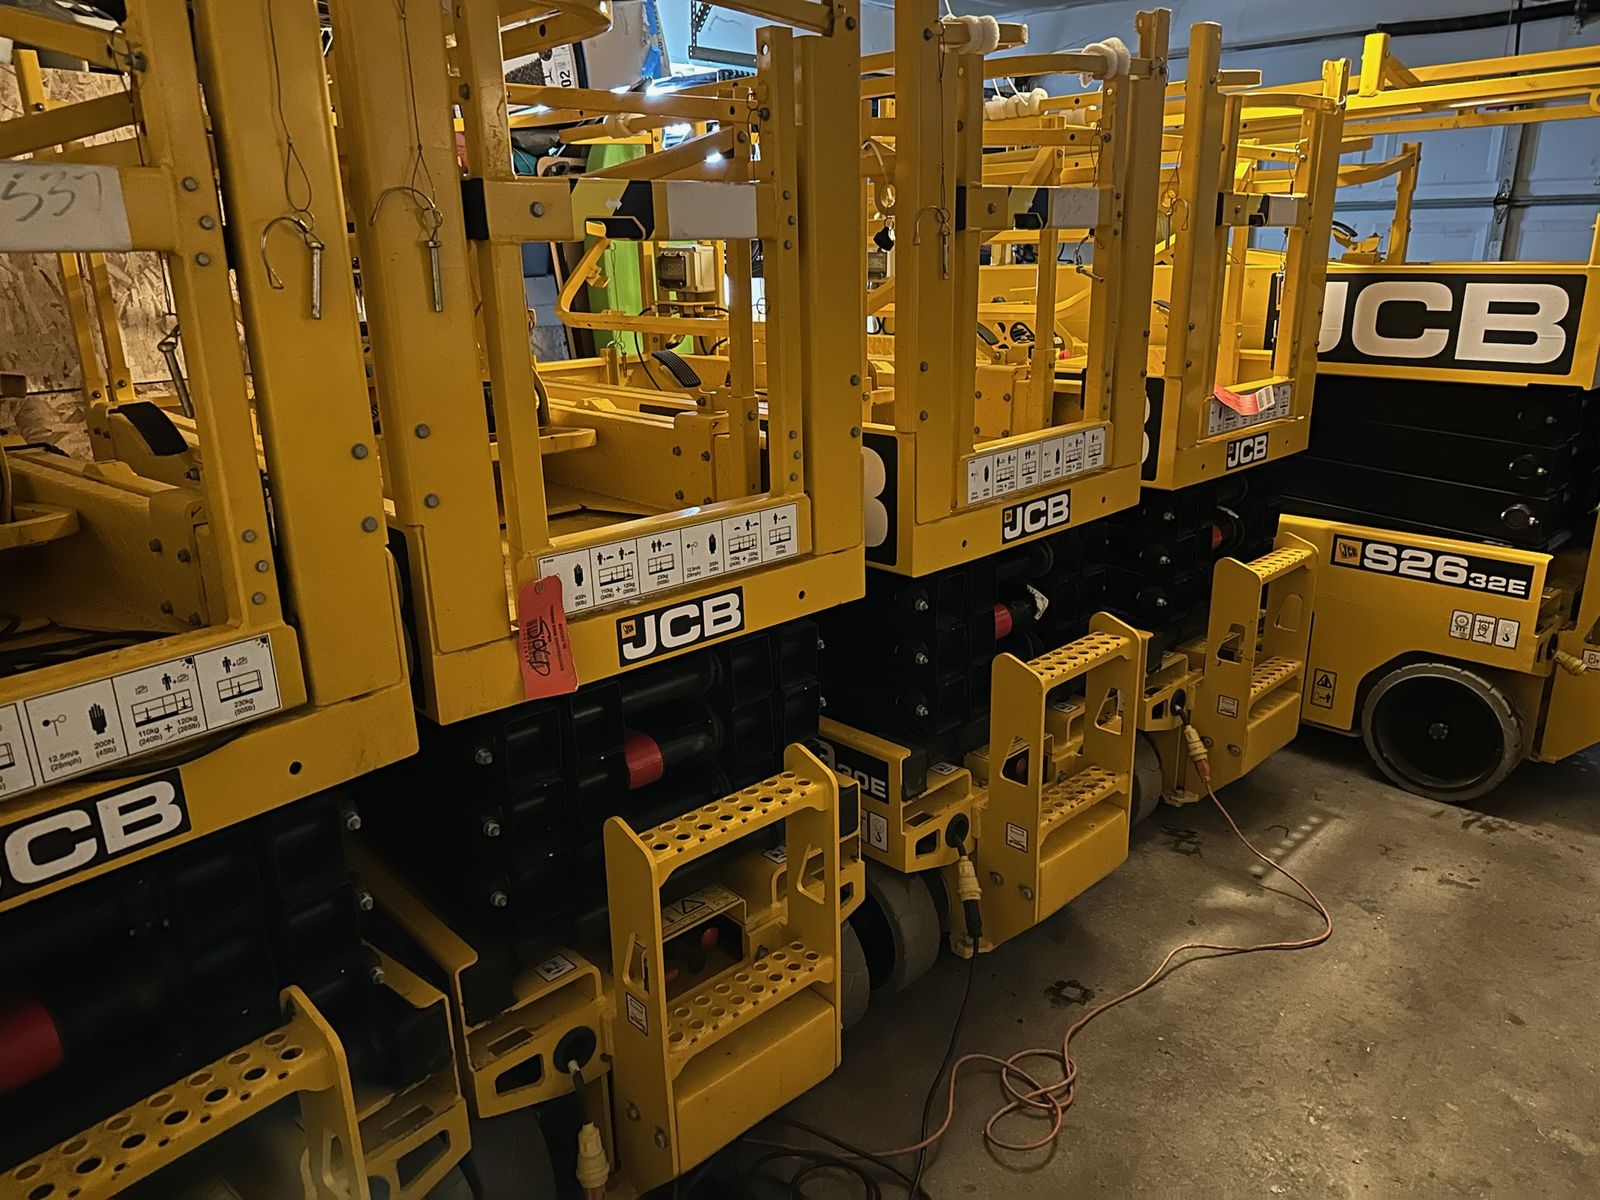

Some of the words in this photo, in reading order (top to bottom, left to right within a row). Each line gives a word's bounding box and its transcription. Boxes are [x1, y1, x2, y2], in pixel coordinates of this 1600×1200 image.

[1317, 281, 1570, 364] JCB
[1227, 435, 1267, 468] JCB
[1004, 493, 1069, 540] JCB
[622, 593, 742, 660] JCB
[527, 615, 551, 676] SOLD
[234, 697, 254, 708] 230kg
[177, 715, 198, 725] 120kg
[94, 737, 115, 749] 200N
[138, 727, 159, 738] 110kg
[48, 749, 79, 763] 12.5m/s
[51, 757, 82, 773] (28mph)
[0, 781, 182, 888] CB
